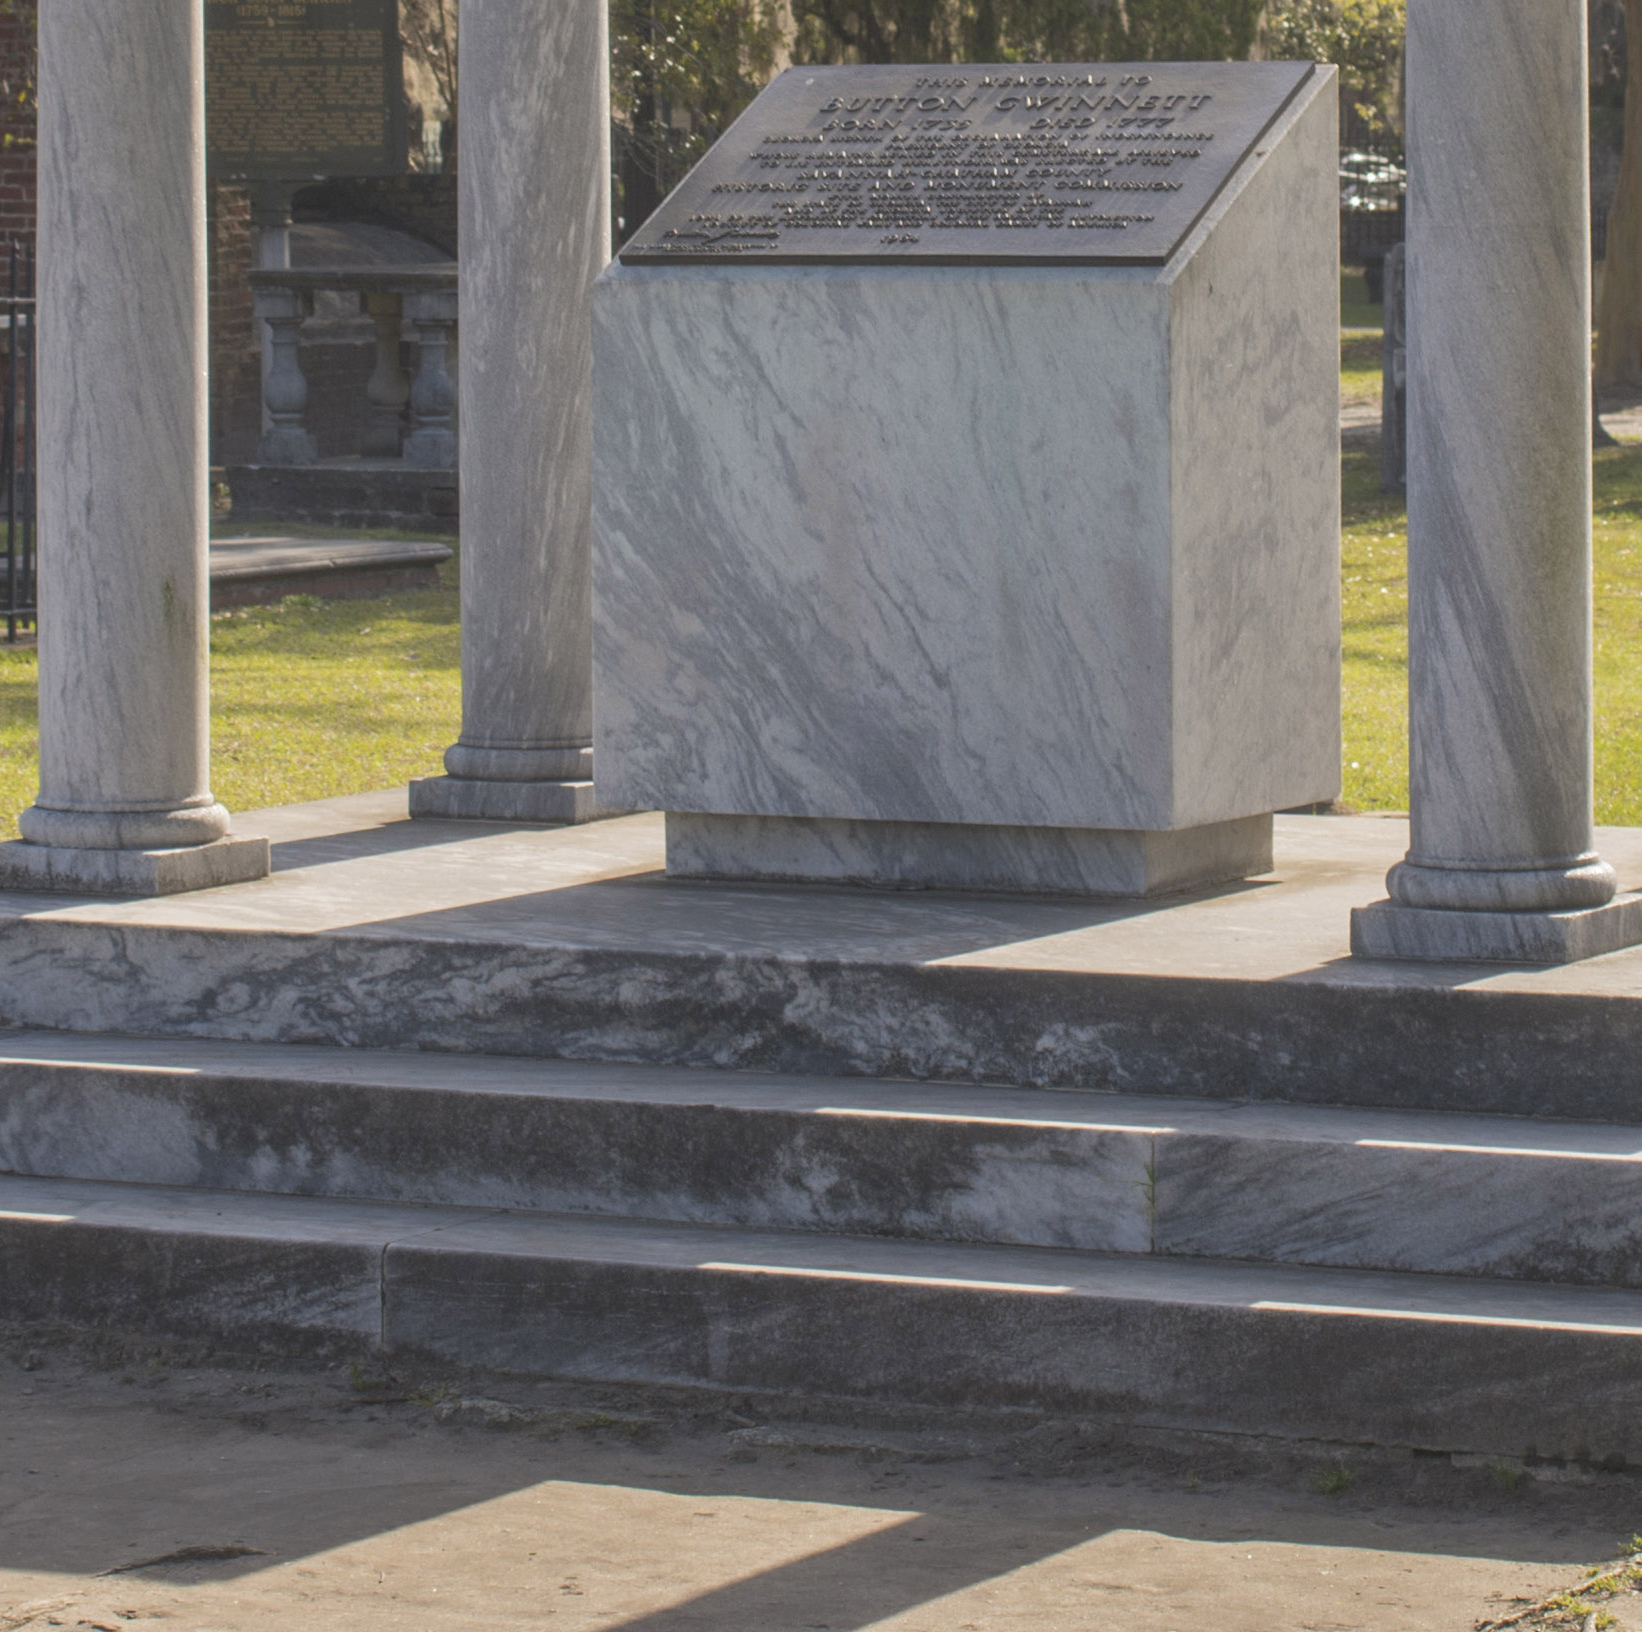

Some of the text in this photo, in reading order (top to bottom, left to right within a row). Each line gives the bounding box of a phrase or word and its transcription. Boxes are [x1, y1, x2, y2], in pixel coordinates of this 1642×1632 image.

[914, 73, 1153, 88] THIS MEMORIAL TO
[819, 93, 1213, 113] BUTTON GWINNETT
[821, 118, 903, 131] BORN
[1029, 117, 1096, 130] DIED
[1106, 117, 1176, 129] 1777
[867, 179, 917, 192] AND
[1054, 178, 1184, 192] COMMISSION
